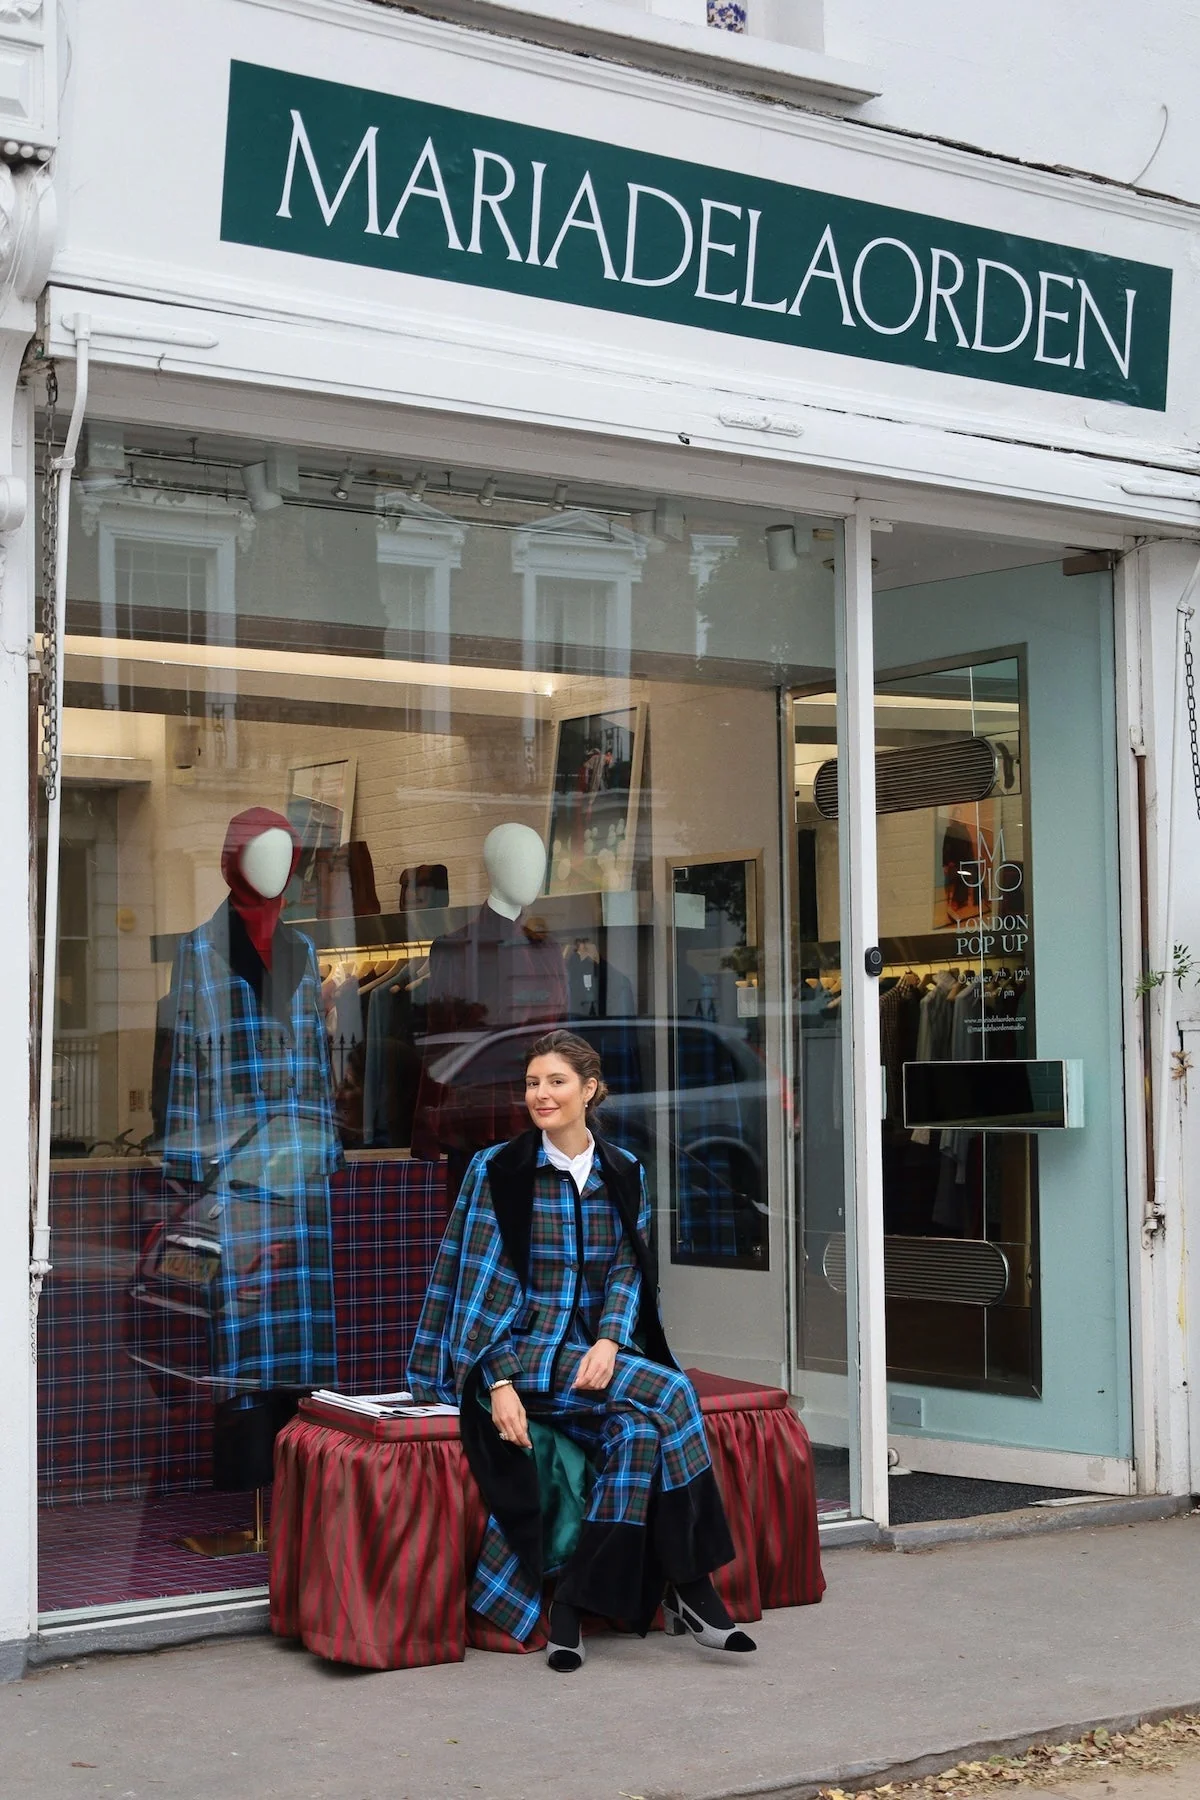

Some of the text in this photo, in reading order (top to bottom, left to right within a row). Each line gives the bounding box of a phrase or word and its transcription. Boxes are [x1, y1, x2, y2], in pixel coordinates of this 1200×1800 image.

[276, 108, 1136, 379] MARIADELAORDEN
[956, 913, 1029, 934] LONDON
[956, 933, 1029, 956] POP UP
[994, 967, 1007, 982] 7th
[1014, 966, 1031, 982] 12th
[1003, 990, 1015, 999] pm
[964, 1014, 1027, 1024] www.mriadelaorden.com
[967, 1023, 1025, 1034] @maradelaordenstudio
